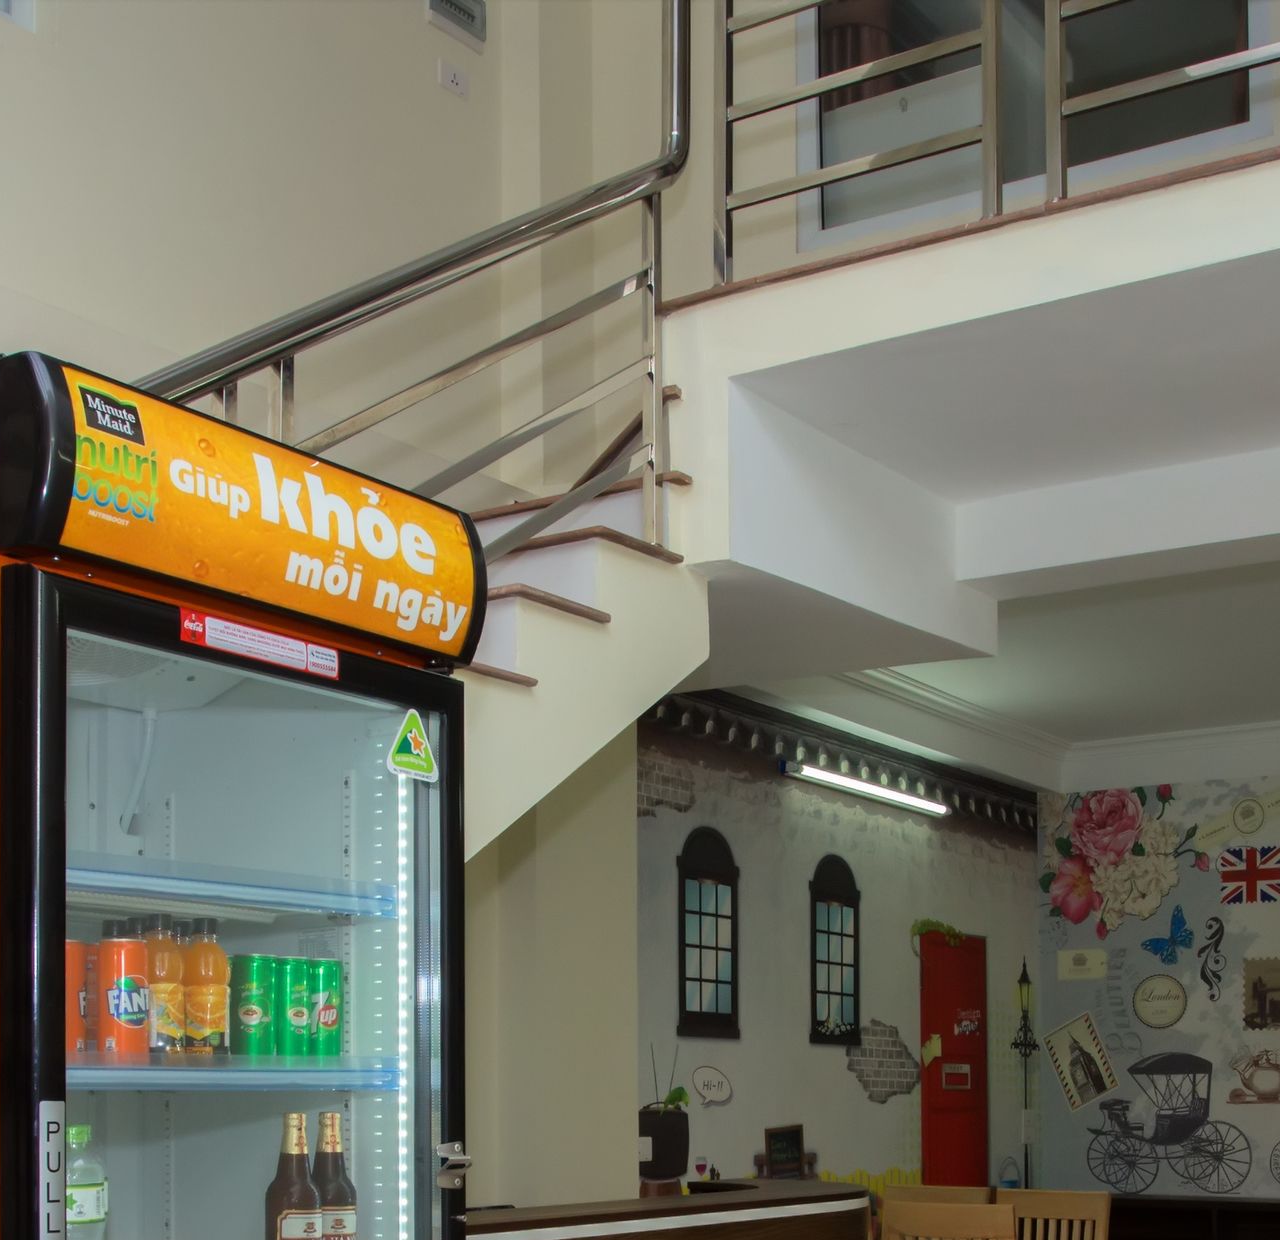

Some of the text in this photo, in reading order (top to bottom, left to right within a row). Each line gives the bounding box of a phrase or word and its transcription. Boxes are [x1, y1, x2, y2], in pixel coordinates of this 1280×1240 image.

[85, 393, 136, 423] Minute
[96, 410, 133, 436] Maid
[169, 452, 437, 576] Giúp khỏe
[285, 550, 363, 602] mỗi
[372, 578, 468, 643] ngày
[46, 1121, 61, 1234] PULL
